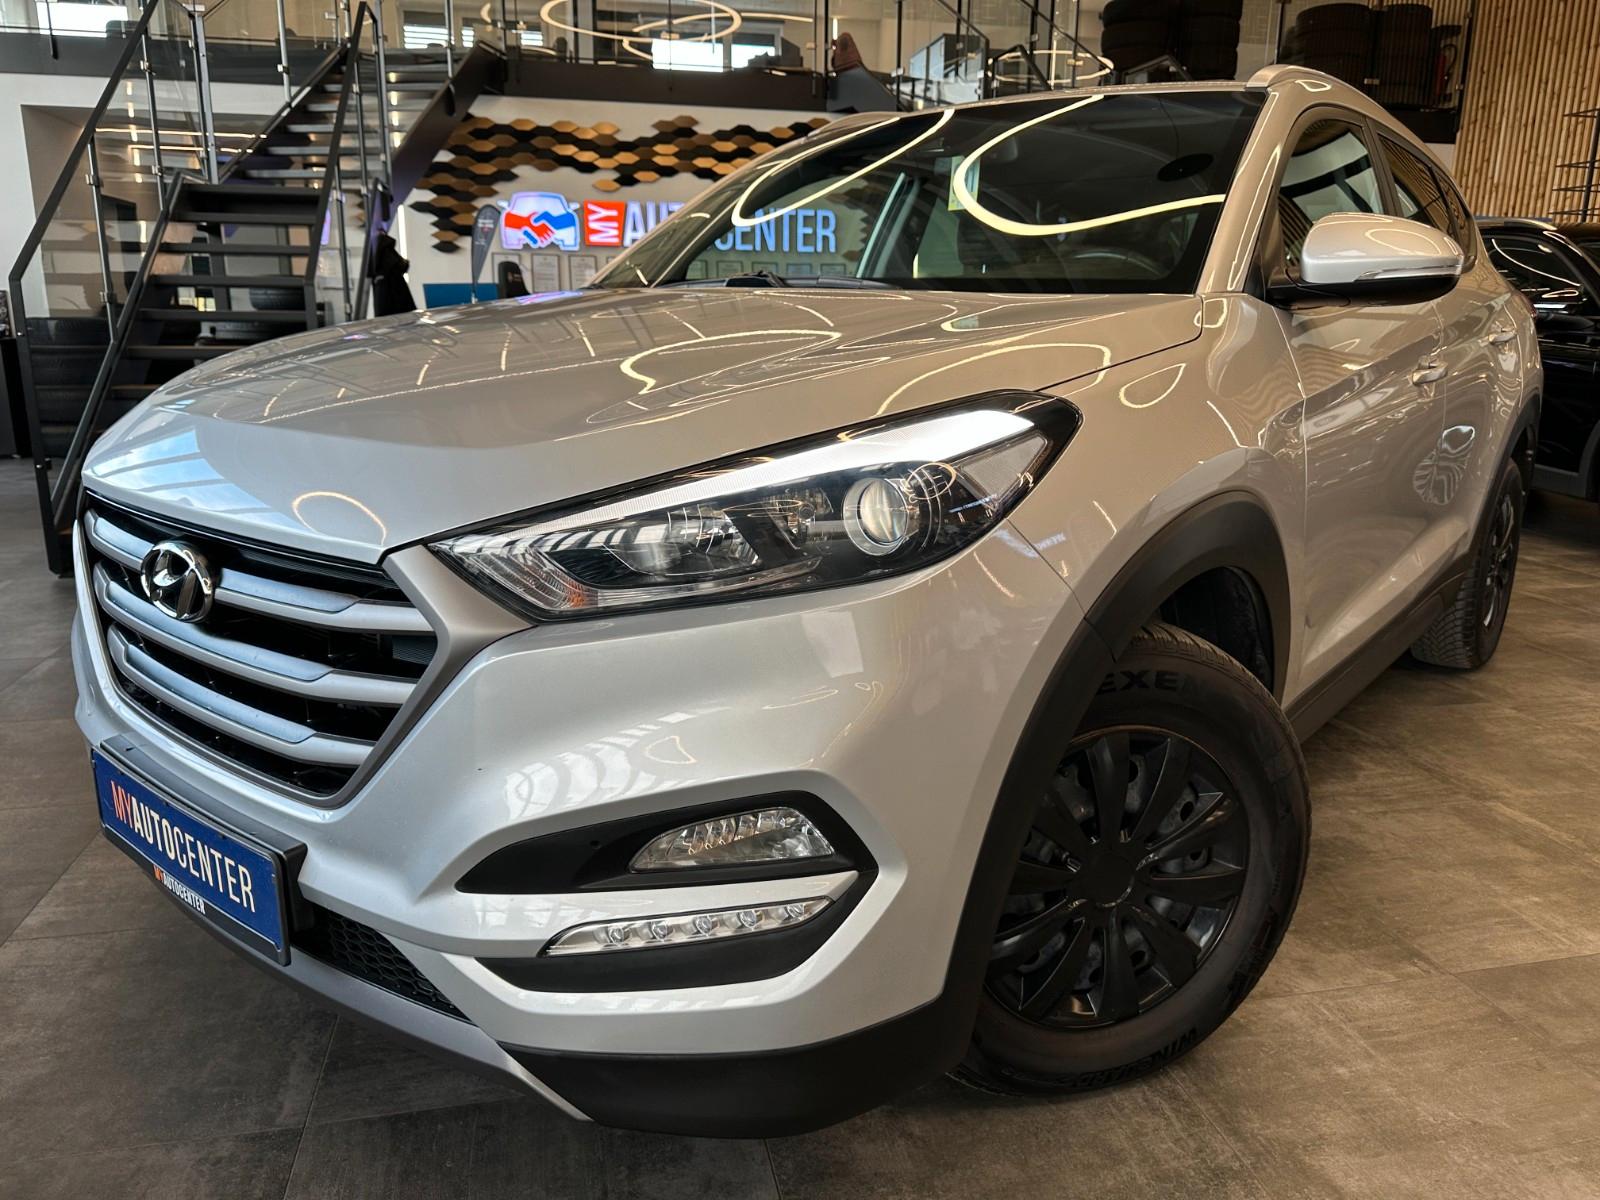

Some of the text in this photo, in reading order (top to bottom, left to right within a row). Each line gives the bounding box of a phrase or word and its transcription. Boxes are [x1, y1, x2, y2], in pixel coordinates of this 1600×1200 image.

[588, 201, 836, 253] MY AENTER
[111, 780, 255, 912] MYAUTOCENTER
